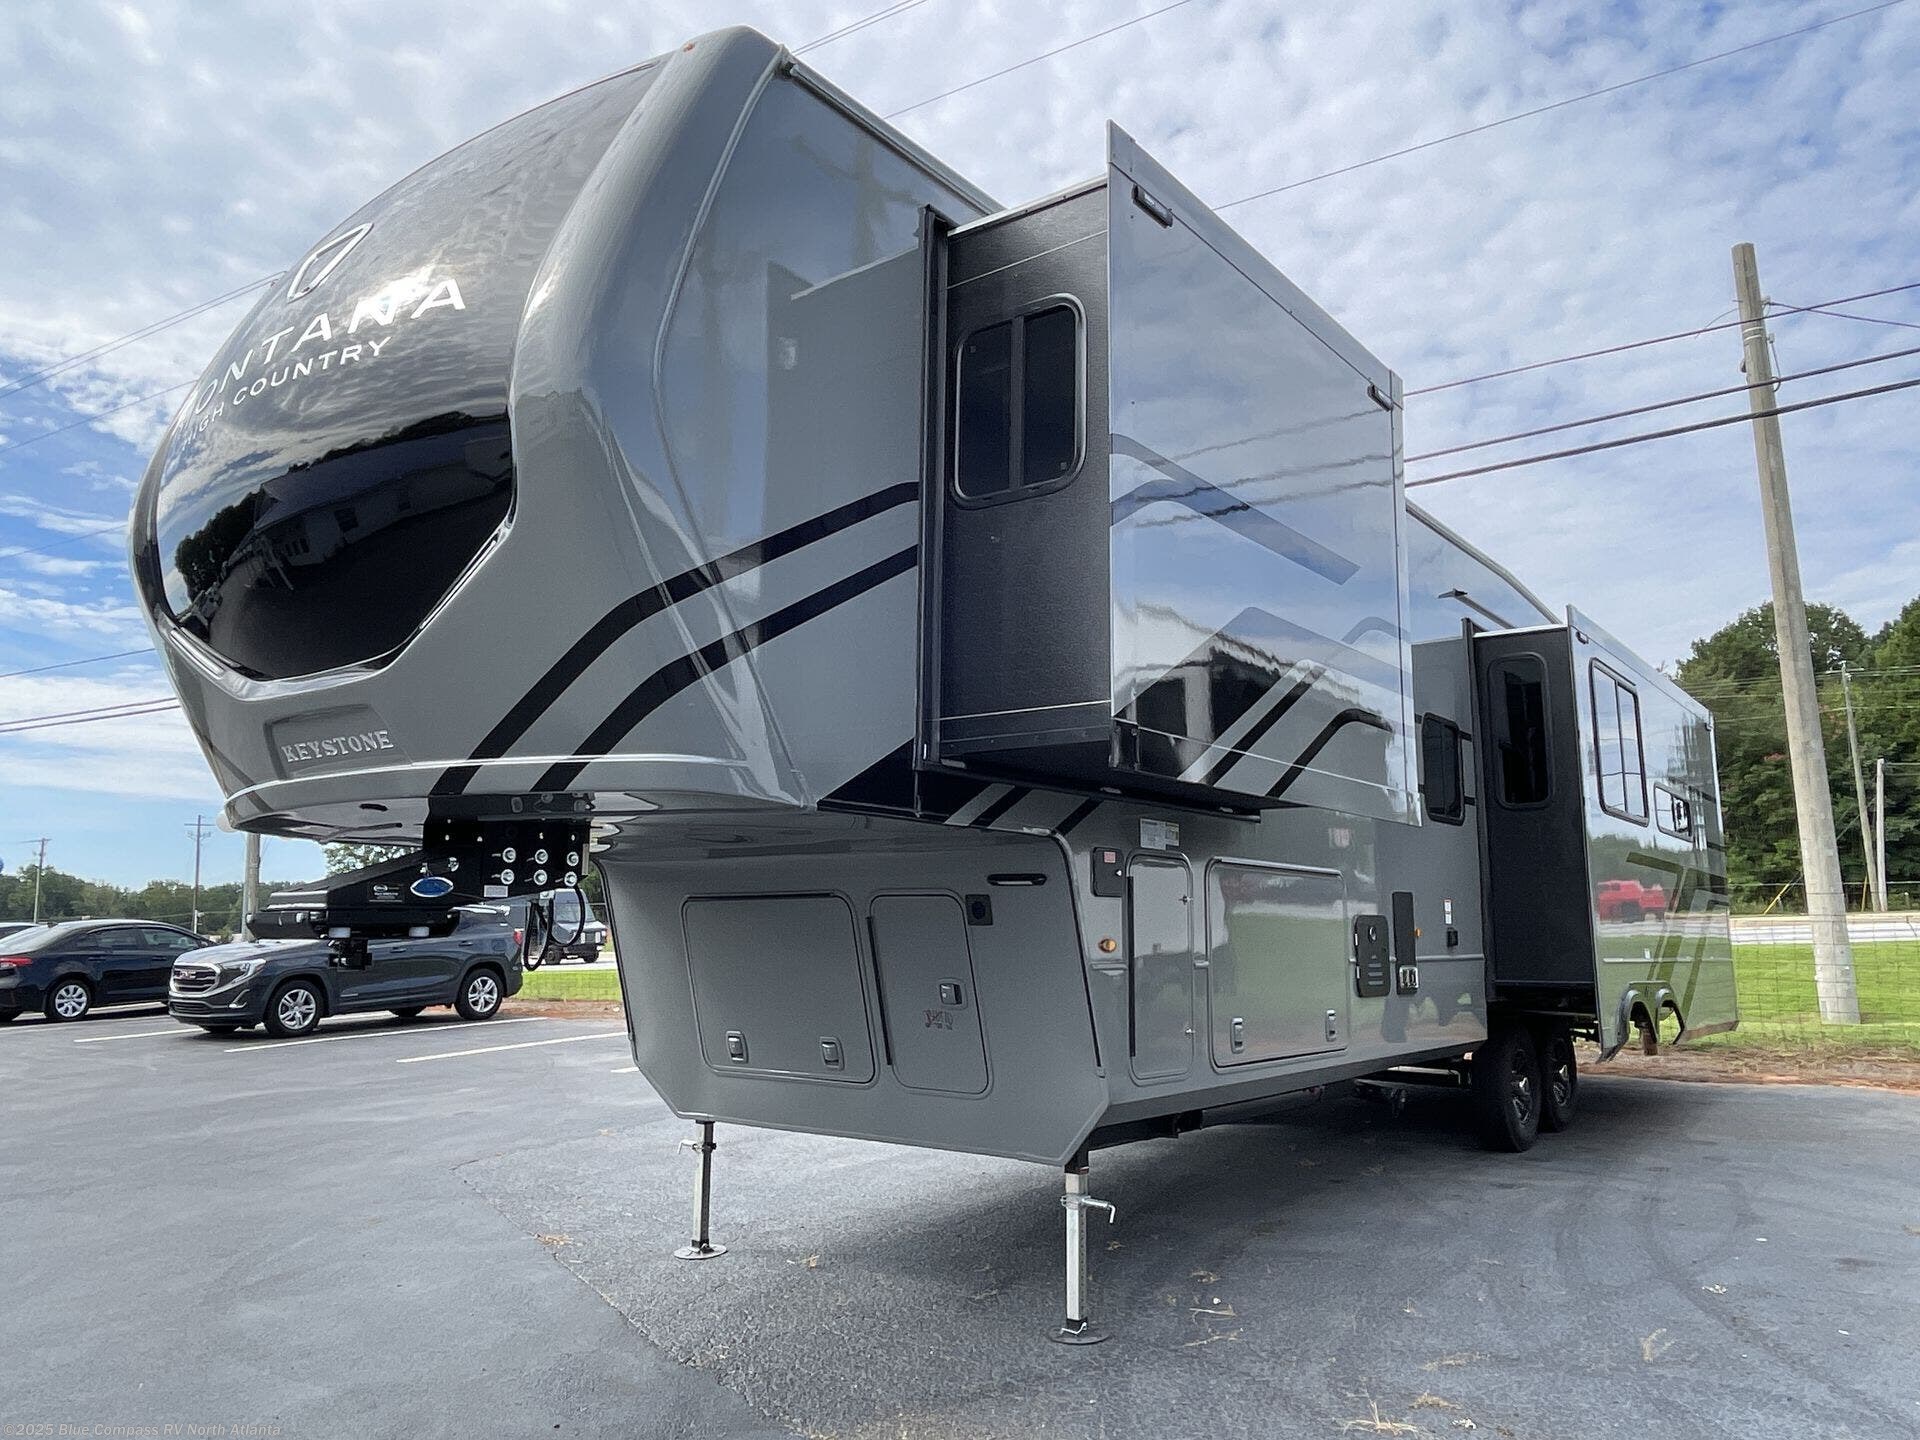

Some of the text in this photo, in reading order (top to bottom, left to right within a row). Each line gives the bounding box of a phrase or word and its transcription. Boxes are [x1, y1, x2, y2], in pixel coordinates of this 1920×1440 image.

[175, 278, 467, 432] ONTANA
[232, 336, 392, 406] COUNTRY
[281, 729, 394, 763] KEYSTONE
